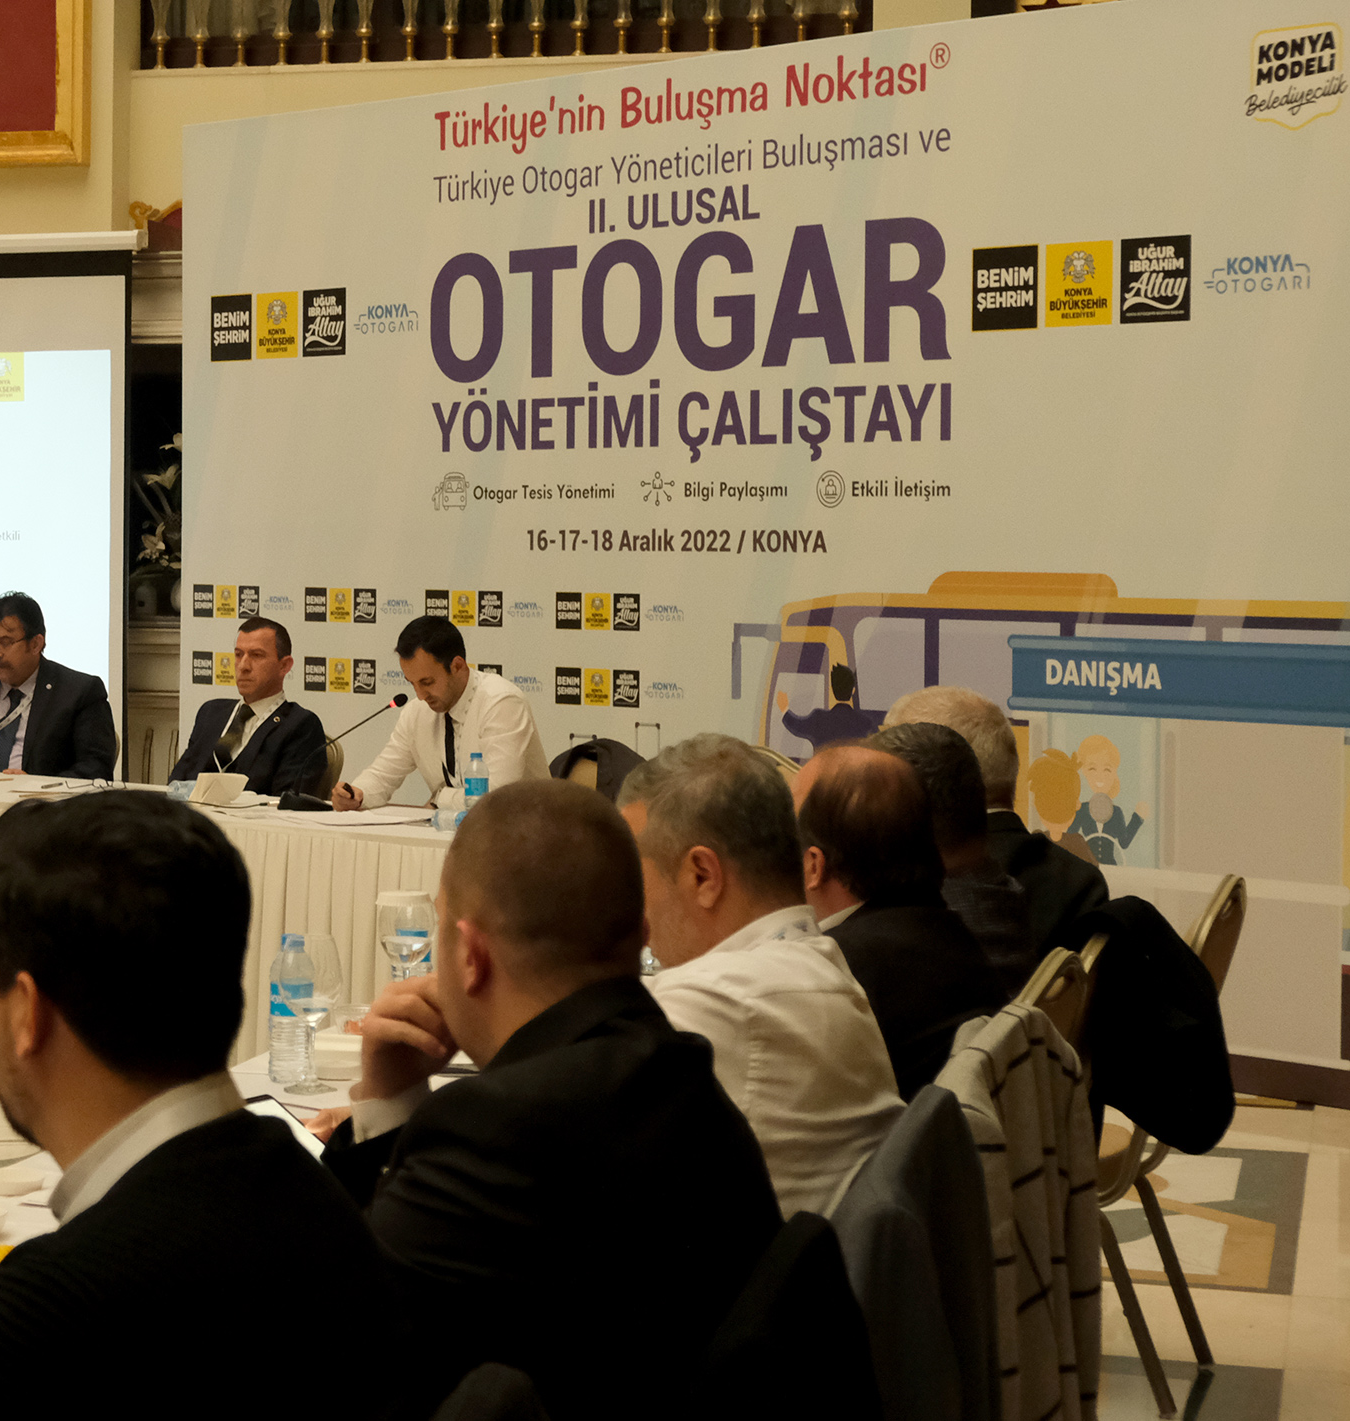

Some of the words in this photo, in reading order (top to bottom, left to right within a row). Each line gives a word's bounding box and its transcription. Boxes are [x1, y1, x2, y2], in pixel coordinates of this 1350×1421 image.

[1258, 31, 1336, 65] KONYA
[1256, 53, 1336, 86] MODELİ
[1244, 74, 1348, 116] Belediyecilik
[434, 94, 605, 154] Türkiye'nin
[621, 78, 768, 130] Buluşma
[433, 169, 515, 205] Türkiye
[523, 165, 603, 197] Otogar
[611, 139, 752, 184] Yöneticileri
[763, 132, 908, 171] Buluşması
[919, 128, 951, 153] ve
[589, 198, 615, 234] II.
[627, 184, 760, 230] ULUSAL
[1137, 243, 1175, 259] UĞUR
[1129, 257, 1184, 273] İBRAHİM
[1227, 254, 1294, 275] KONYA
[977, 266, 1034, 289] BENİM
[313, 294, 337, 306] UĞUR
[430, 217, 952, 383] OTOGAR
[977, 289, 1034, 312] ŞEHRİM
[1064, 287, 1093, 297] KONYA
[1124, 272, 1188, 309] Altay
[308, 304, 342, 317] İBRAHİM
[367, 303, 409, 320] KONYA
[1049, 297, 1108, 311] BÜYÜKŞEHİR
[213, 311, 250, 328] BENİM
[305, 316, 344, 345] Altay
[213, 328, 250, 346] ŞEHRİM
[432, 379, 660, 453] YÖNETİMİ
[678, 383, 952, 463] ÇALIŞTAYI
[473, 485, 518, 503] Otogar
[522, 484, 553, 500] Tesis
[557, 483, 615, 499] Yönetimi
[684, 481, 714, 501] Bilgi
[719, 481, 788, 501] Paylaşımı
[851, 480, 888, 497] Etkili
[894, 476, 951, 501] İletişim
[527, 529, 613, 551] 16-17-18
[619, 528, 675, 552] Aralık
[680, 529, 731, 552] 2022
[752, 530, 827, 553] KONYA
[1046, 659, 1162, 695] DANIŞMA
